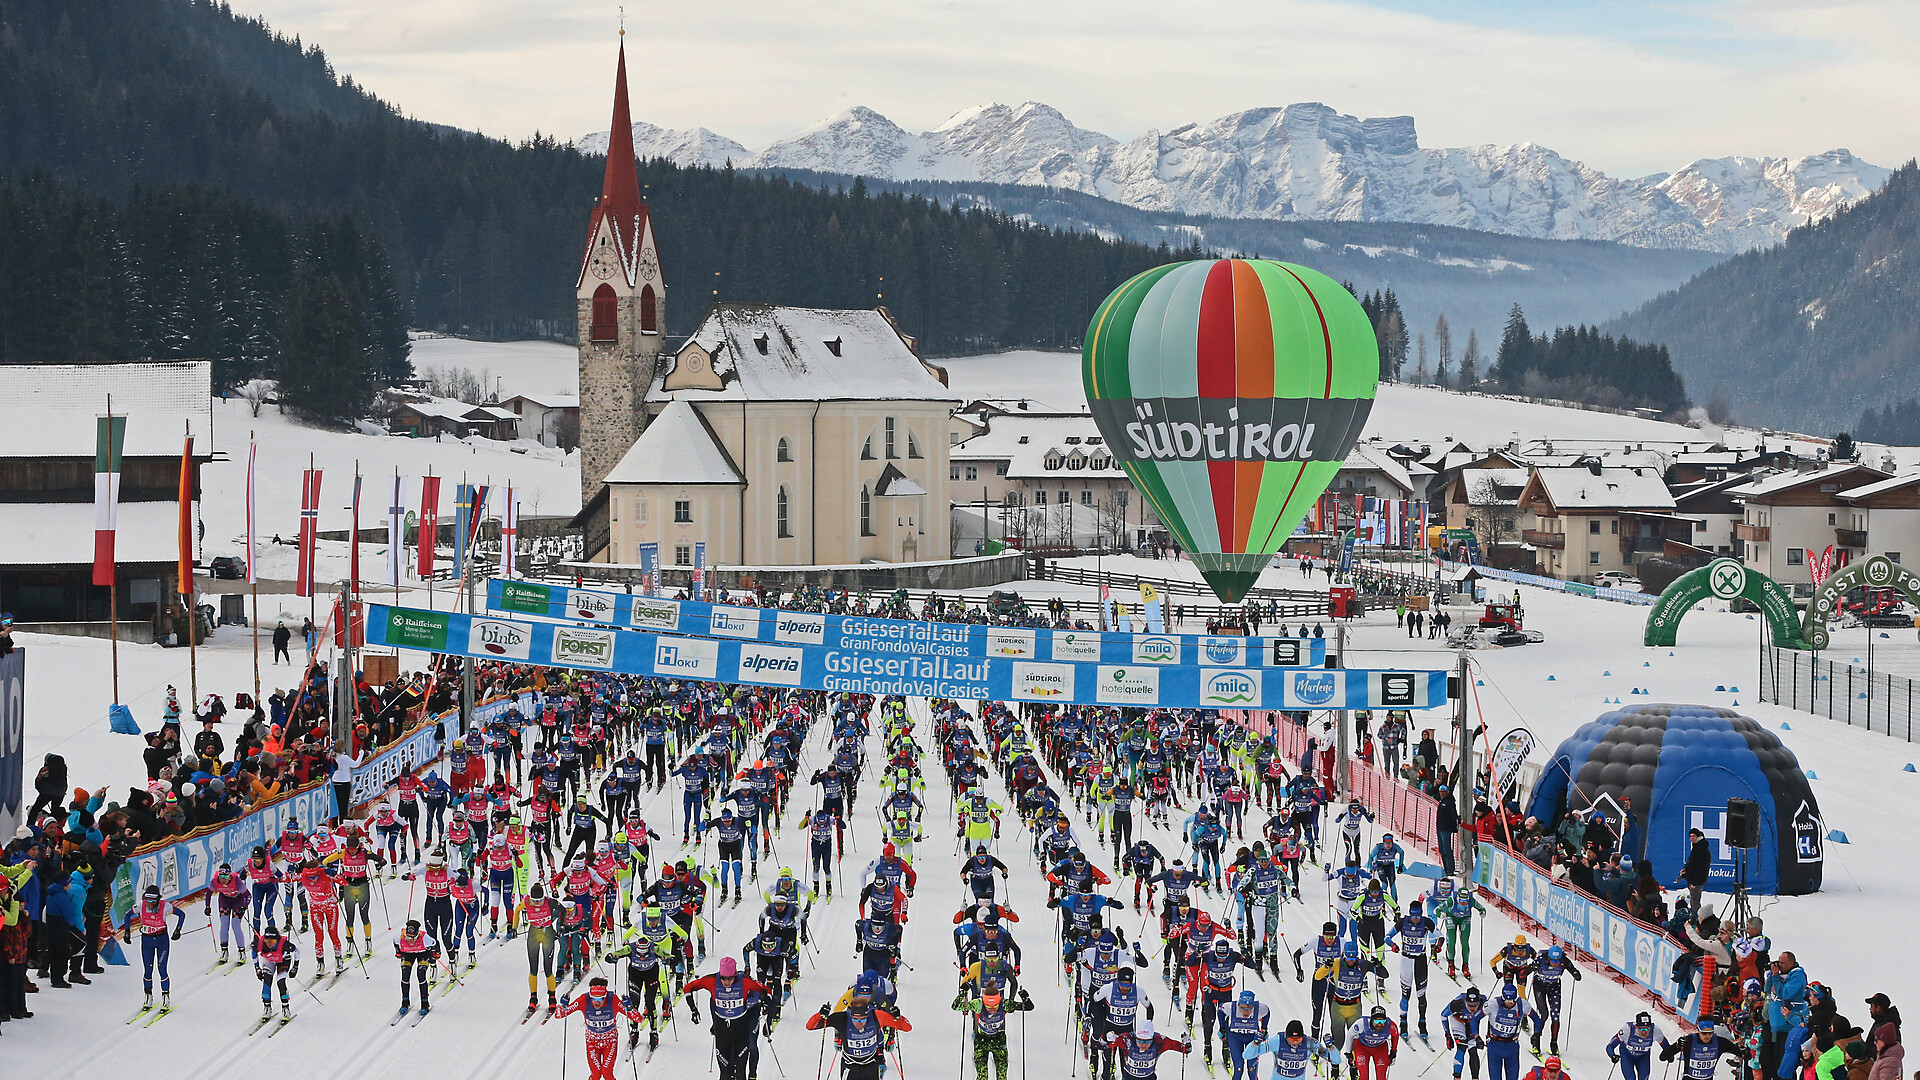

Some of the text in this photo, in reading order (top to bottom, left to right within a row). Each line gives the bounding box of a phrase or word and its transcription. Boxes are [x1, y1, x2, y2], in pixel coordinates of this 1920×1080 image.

[516, 589, 546, 598] Raiffeisen
[1812, 571, 1857, 624] FORST
[1660, 591, 1683, 619] Raiffeisen
[637, 606, 674, 620] FORST
[405, 618, 442, 630] Raiffeisen
[779, 620, 822, 634] alperia
[841, 618, 971, 643] GsieserTalLauf
[481, 625, 523, 645] binta
[561, 639, 607, 655] FORST
[840, 636, 969, 657] GranFondoValCasies
[1144, 642, 1171, 653] mila
[1207, 642, 1236, 657] Marlene
[743, 654, 799, 672] alperia
[824, 651, 991, 681] GsieserTalLauf
[823, 675, 990, 699] GranFondoValCasies
[1102, 684, 1154, 694] hotelquelle
[1215, 680, 1250, 693] mila
[1297, 679, 1333, 697] Marlene
[855, 1039, 871, 1047] 512
[1696, 1061, 1711, 1069] 509
